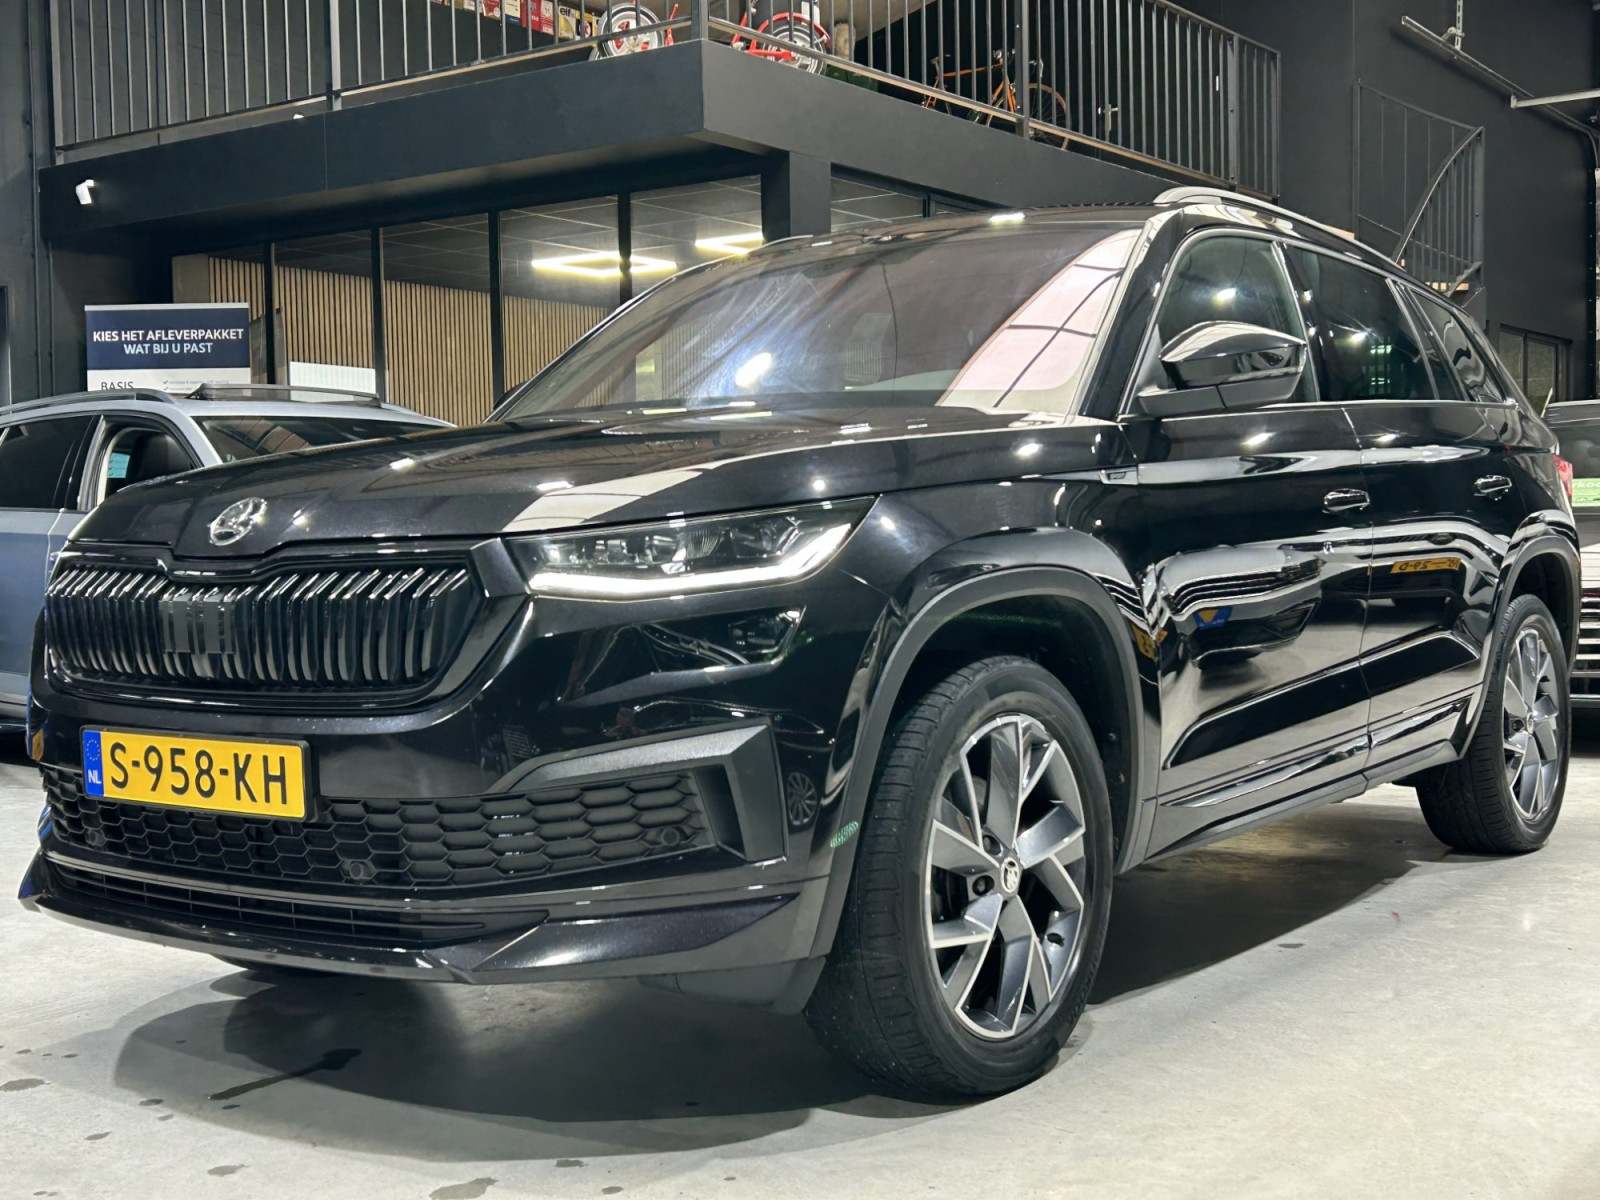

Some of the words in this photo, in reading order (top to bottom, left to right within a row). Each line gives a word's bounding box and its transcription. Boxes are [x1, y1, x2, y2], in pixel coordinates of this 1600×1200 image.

[560, 7, 571, 17] elf
[93, 331, 119, 342] KIES
[121, 330, 144, 341] HET
[146, 328, 244, 341] AFLEVERPAKKET
[123, 343, 150, 354] WAT
[153, 343, 169, 354] BIJ
[171, 343, 180, 354] U
[183, 342, 213, 353] PAST
[87, 769, 101, 784] NL
[110, 742, 287, 805] S-958-KH
